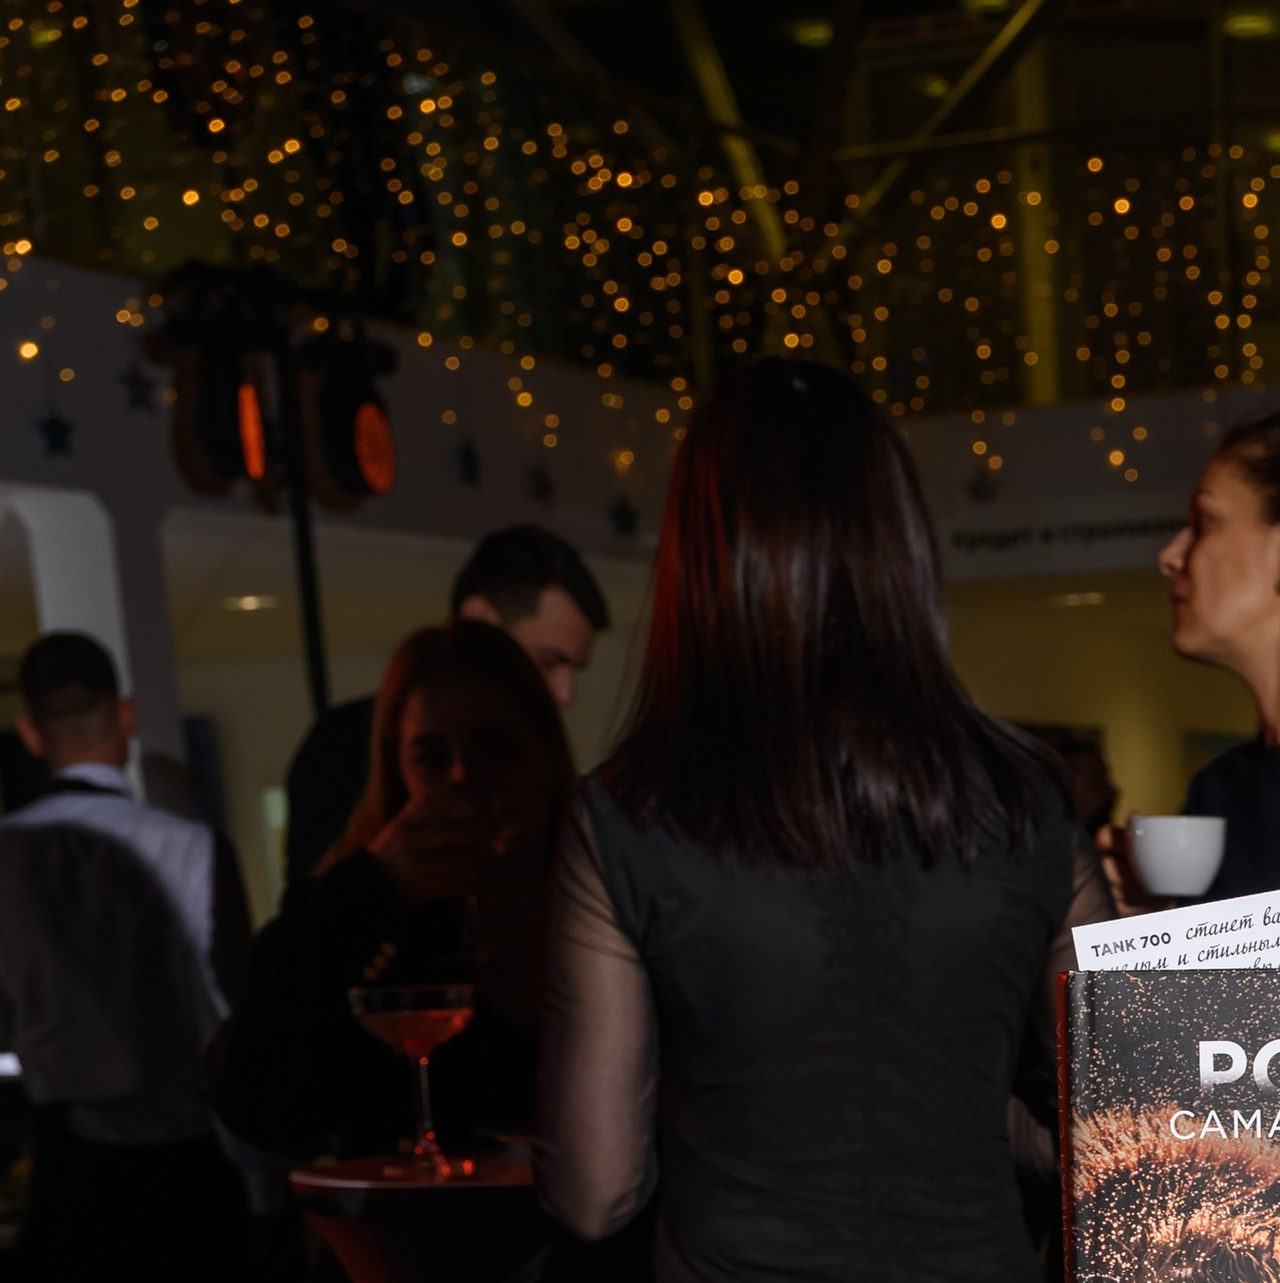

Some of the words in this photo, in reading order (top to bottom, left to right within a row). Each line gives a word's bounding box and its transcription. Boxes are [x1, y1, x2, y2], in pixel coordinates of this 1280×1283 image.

[1185, 913, 1255, 940] станет
[1091, 938, 1137, 958] TANK
[1140, 932, 1172, 949] 700
[1178, 953, 1189, 966] и
